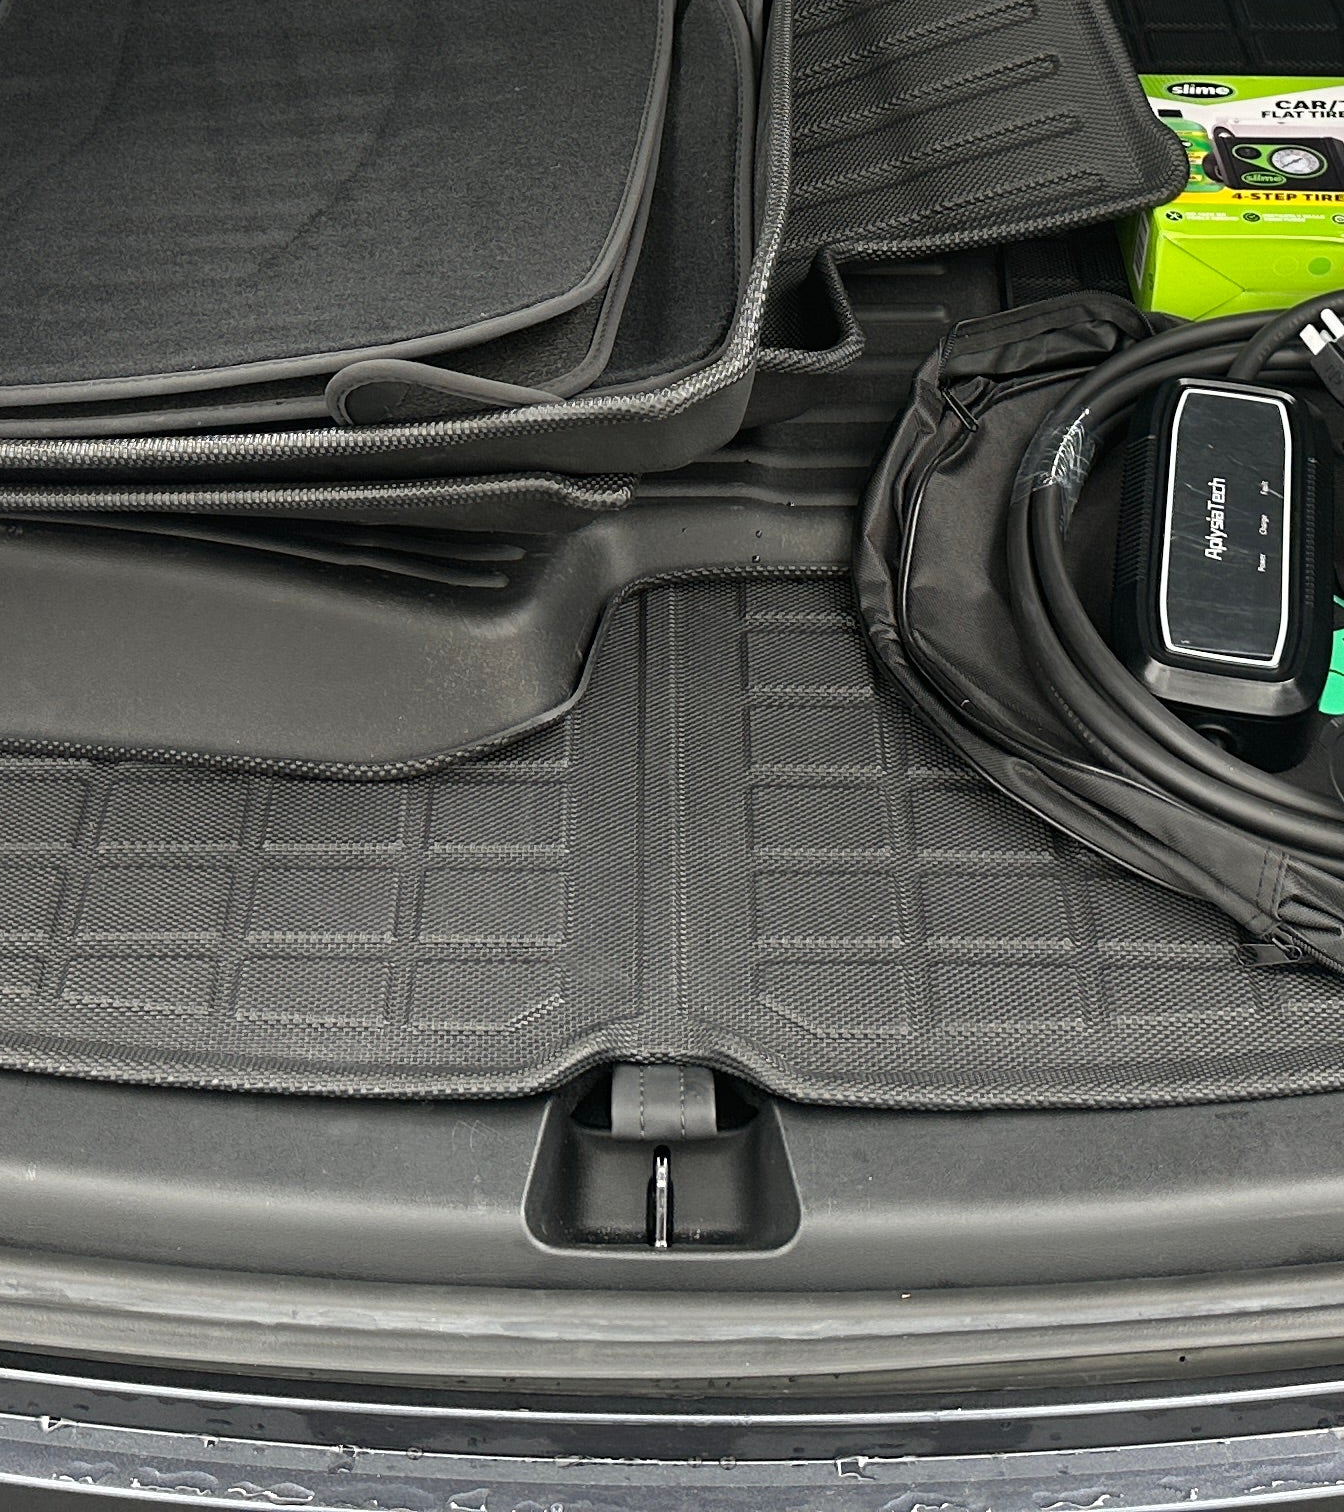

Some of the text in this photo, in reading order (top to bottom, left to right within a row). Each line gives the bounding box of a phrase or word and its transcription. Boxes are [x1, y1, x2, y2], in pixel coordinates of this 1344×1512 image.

[1171, 83, 1230, 96] slime
[1260, 110, 1304, 119] FLAT
[1231, 192, 1298, 202] 4-STEP
[1303, 193, 1344, 203] TIRE
[1204, 477, 1228, 561] AplysiaTech
